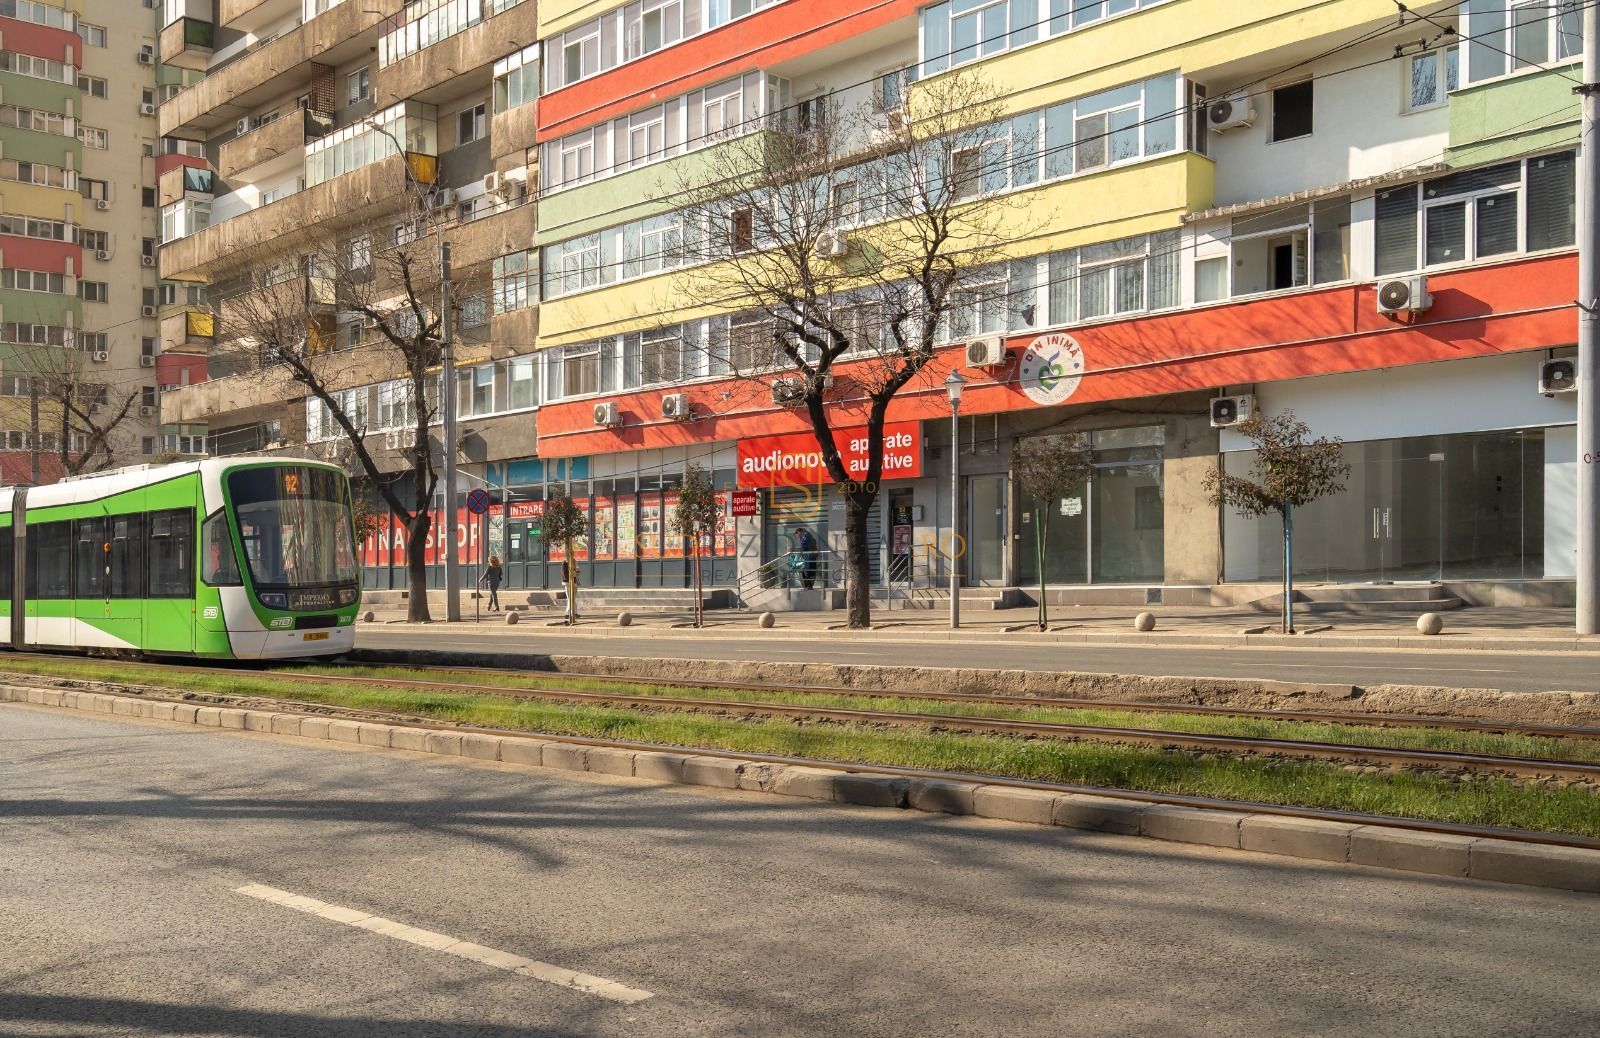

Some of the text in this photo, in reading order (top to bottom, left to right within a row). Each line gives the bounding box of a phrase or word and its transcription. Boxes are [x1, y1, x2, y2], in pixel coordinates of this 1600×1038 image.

[1025, 335, 1080, 362] DIN INIMĂ
[850, 432, 912, 454] apate
[743, 450, 842, 473] audionov
[850, 453, 913, 472] autive
[510, 504, 543, 516] INTRARE
[732, 496, 756, 505] aparate
[732, 504, 756, 512] auditive
